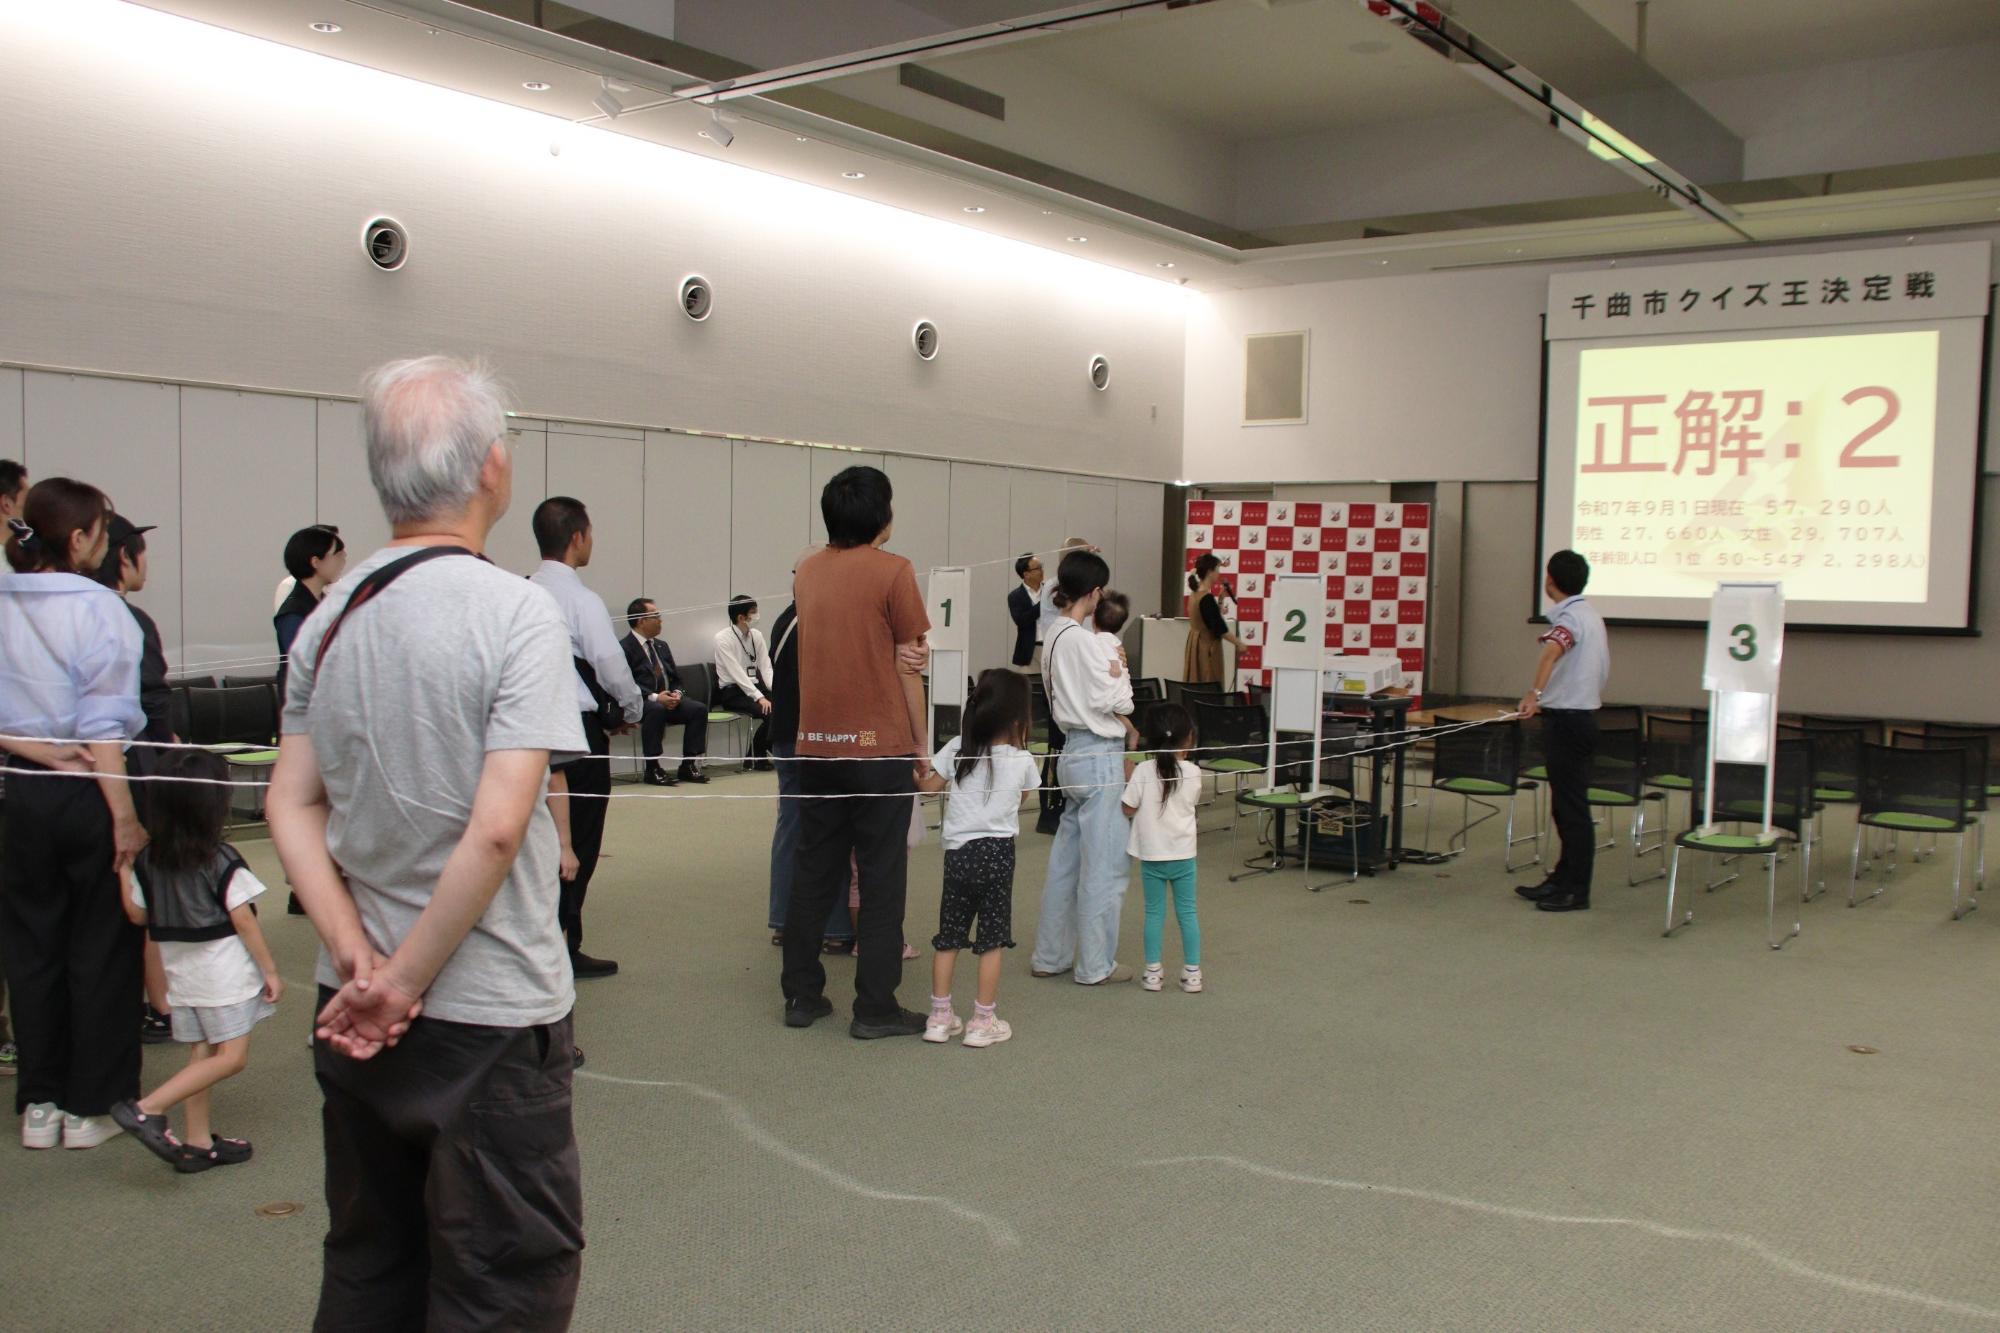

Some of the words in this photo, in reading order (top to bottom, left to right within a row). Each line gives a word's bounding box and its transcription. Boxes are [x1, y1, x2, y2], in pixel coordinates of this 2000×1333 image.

[1571, 271, 1935, 320] 千曲市クイズ王決定戦
[1576, 526, 1603, 541] 男性
[941, 598, 952, 627] 1
[1283, 609, 1306, 642] 2
[1728, 623, 1758, 661] 3
[808, 732, 823, 741] BE
[825, 733, 857, 743] HAPPY
